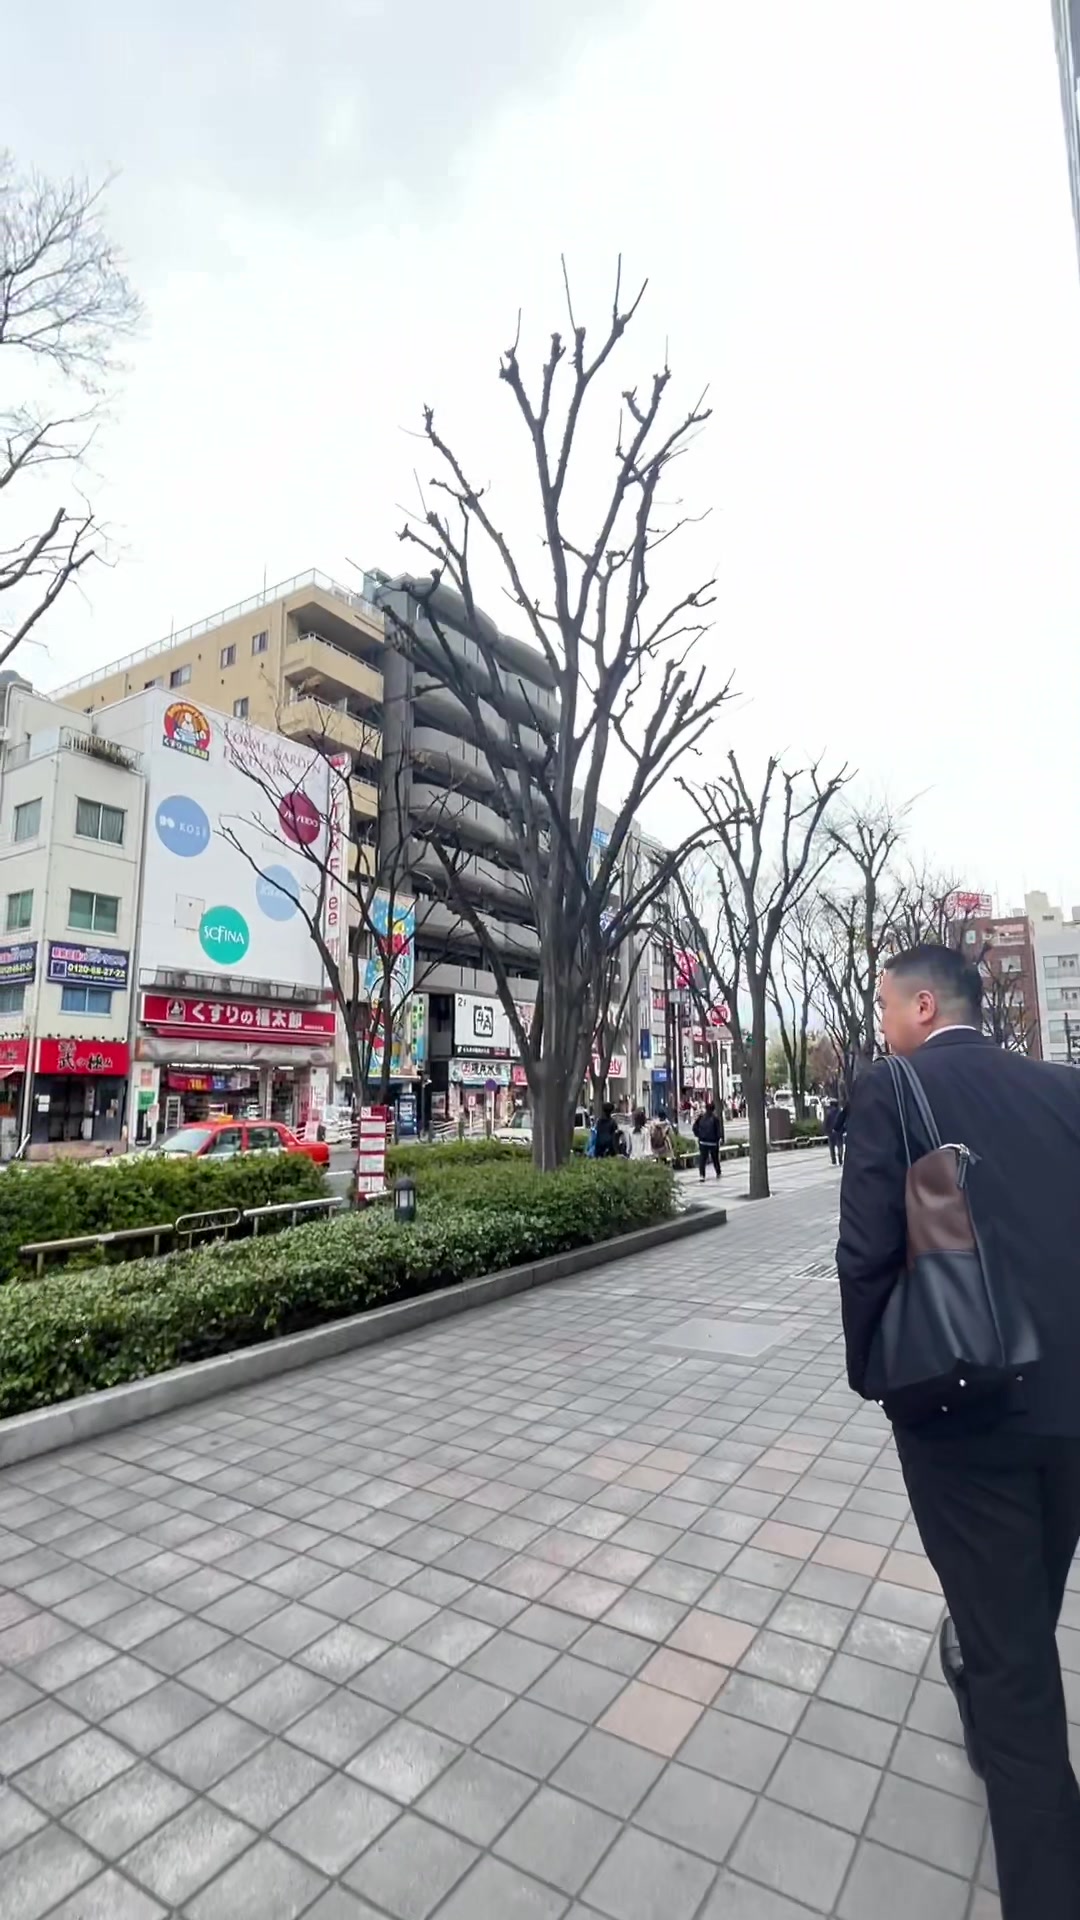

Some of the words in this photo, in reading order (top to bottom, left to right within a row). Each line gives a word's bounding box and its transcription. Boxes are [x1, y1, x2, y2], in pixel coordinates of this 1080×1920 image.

[328, 858, 340, 926] Free
[203, 924, 245, 945] SOFINA
[192, 1002, 302, 1029] くすりの福太郎
